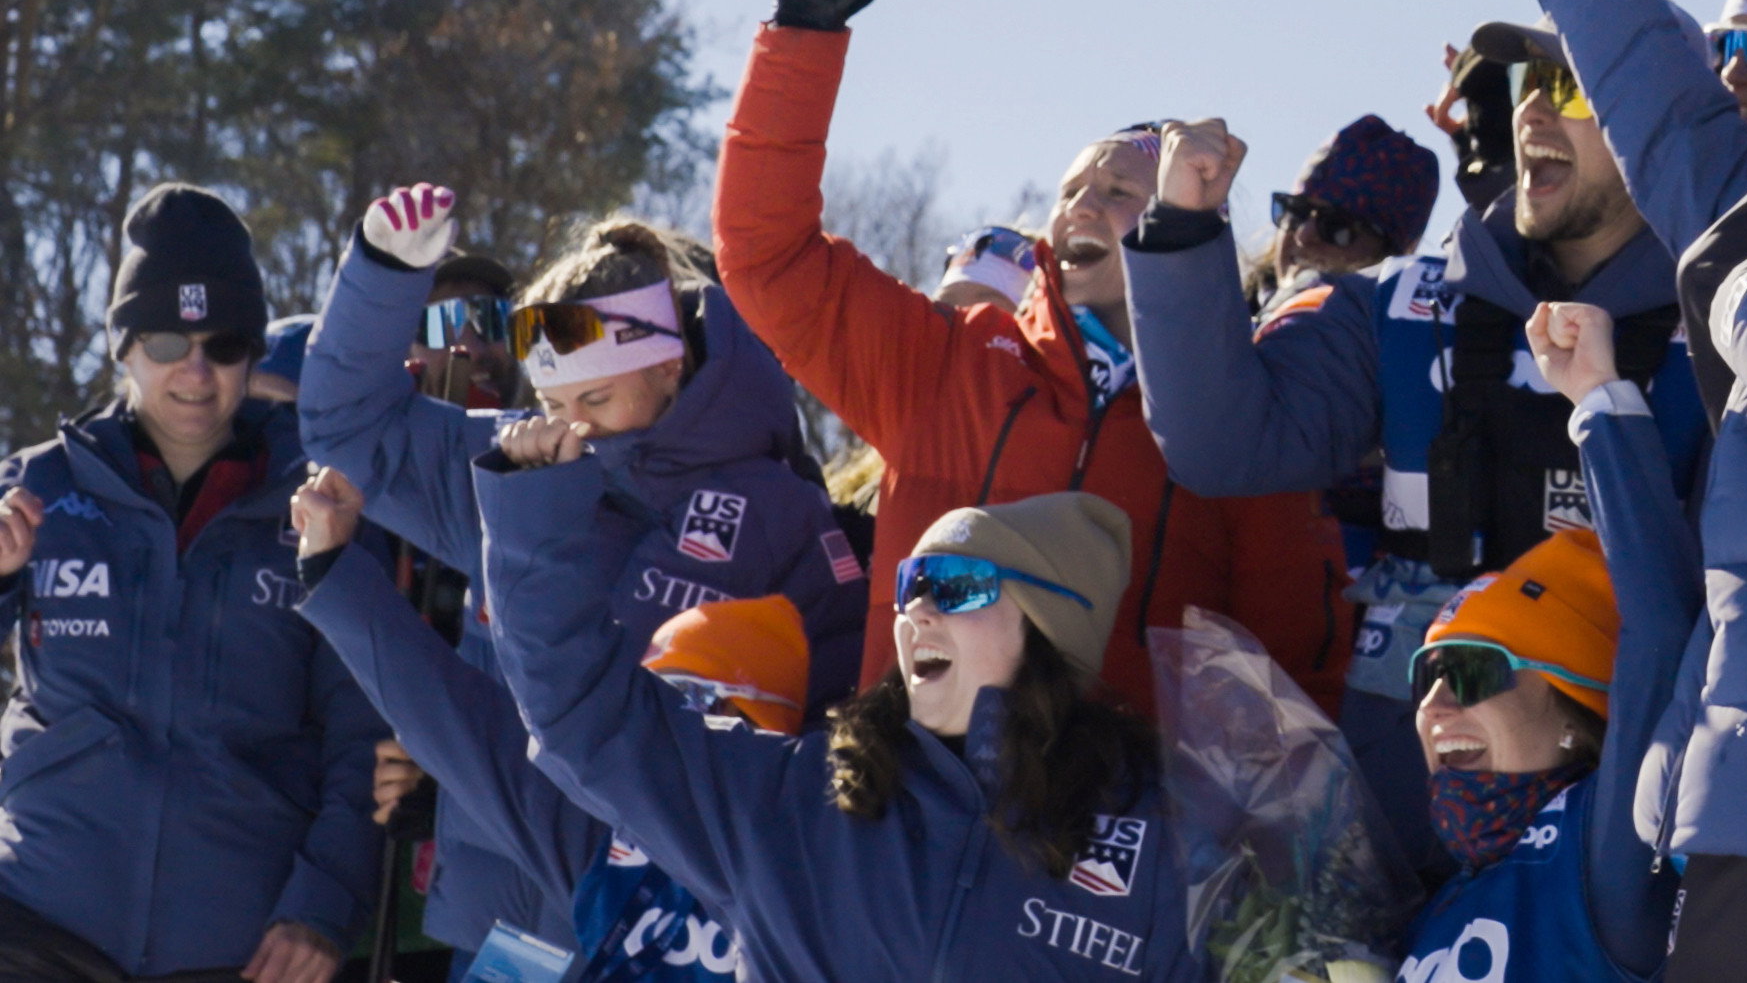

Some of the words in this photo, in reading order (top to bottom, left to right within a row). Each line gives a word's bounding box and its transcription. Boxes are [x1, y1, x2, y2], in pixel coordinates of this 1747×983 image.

[693, 494, 742, 520] US
[27, 560, 110, 597] VISA
[634, 567, 737, 610] STIF
[42, 620, 110, 636] TOYOTA
[1017, 898, 1144, 976] STIFEL
